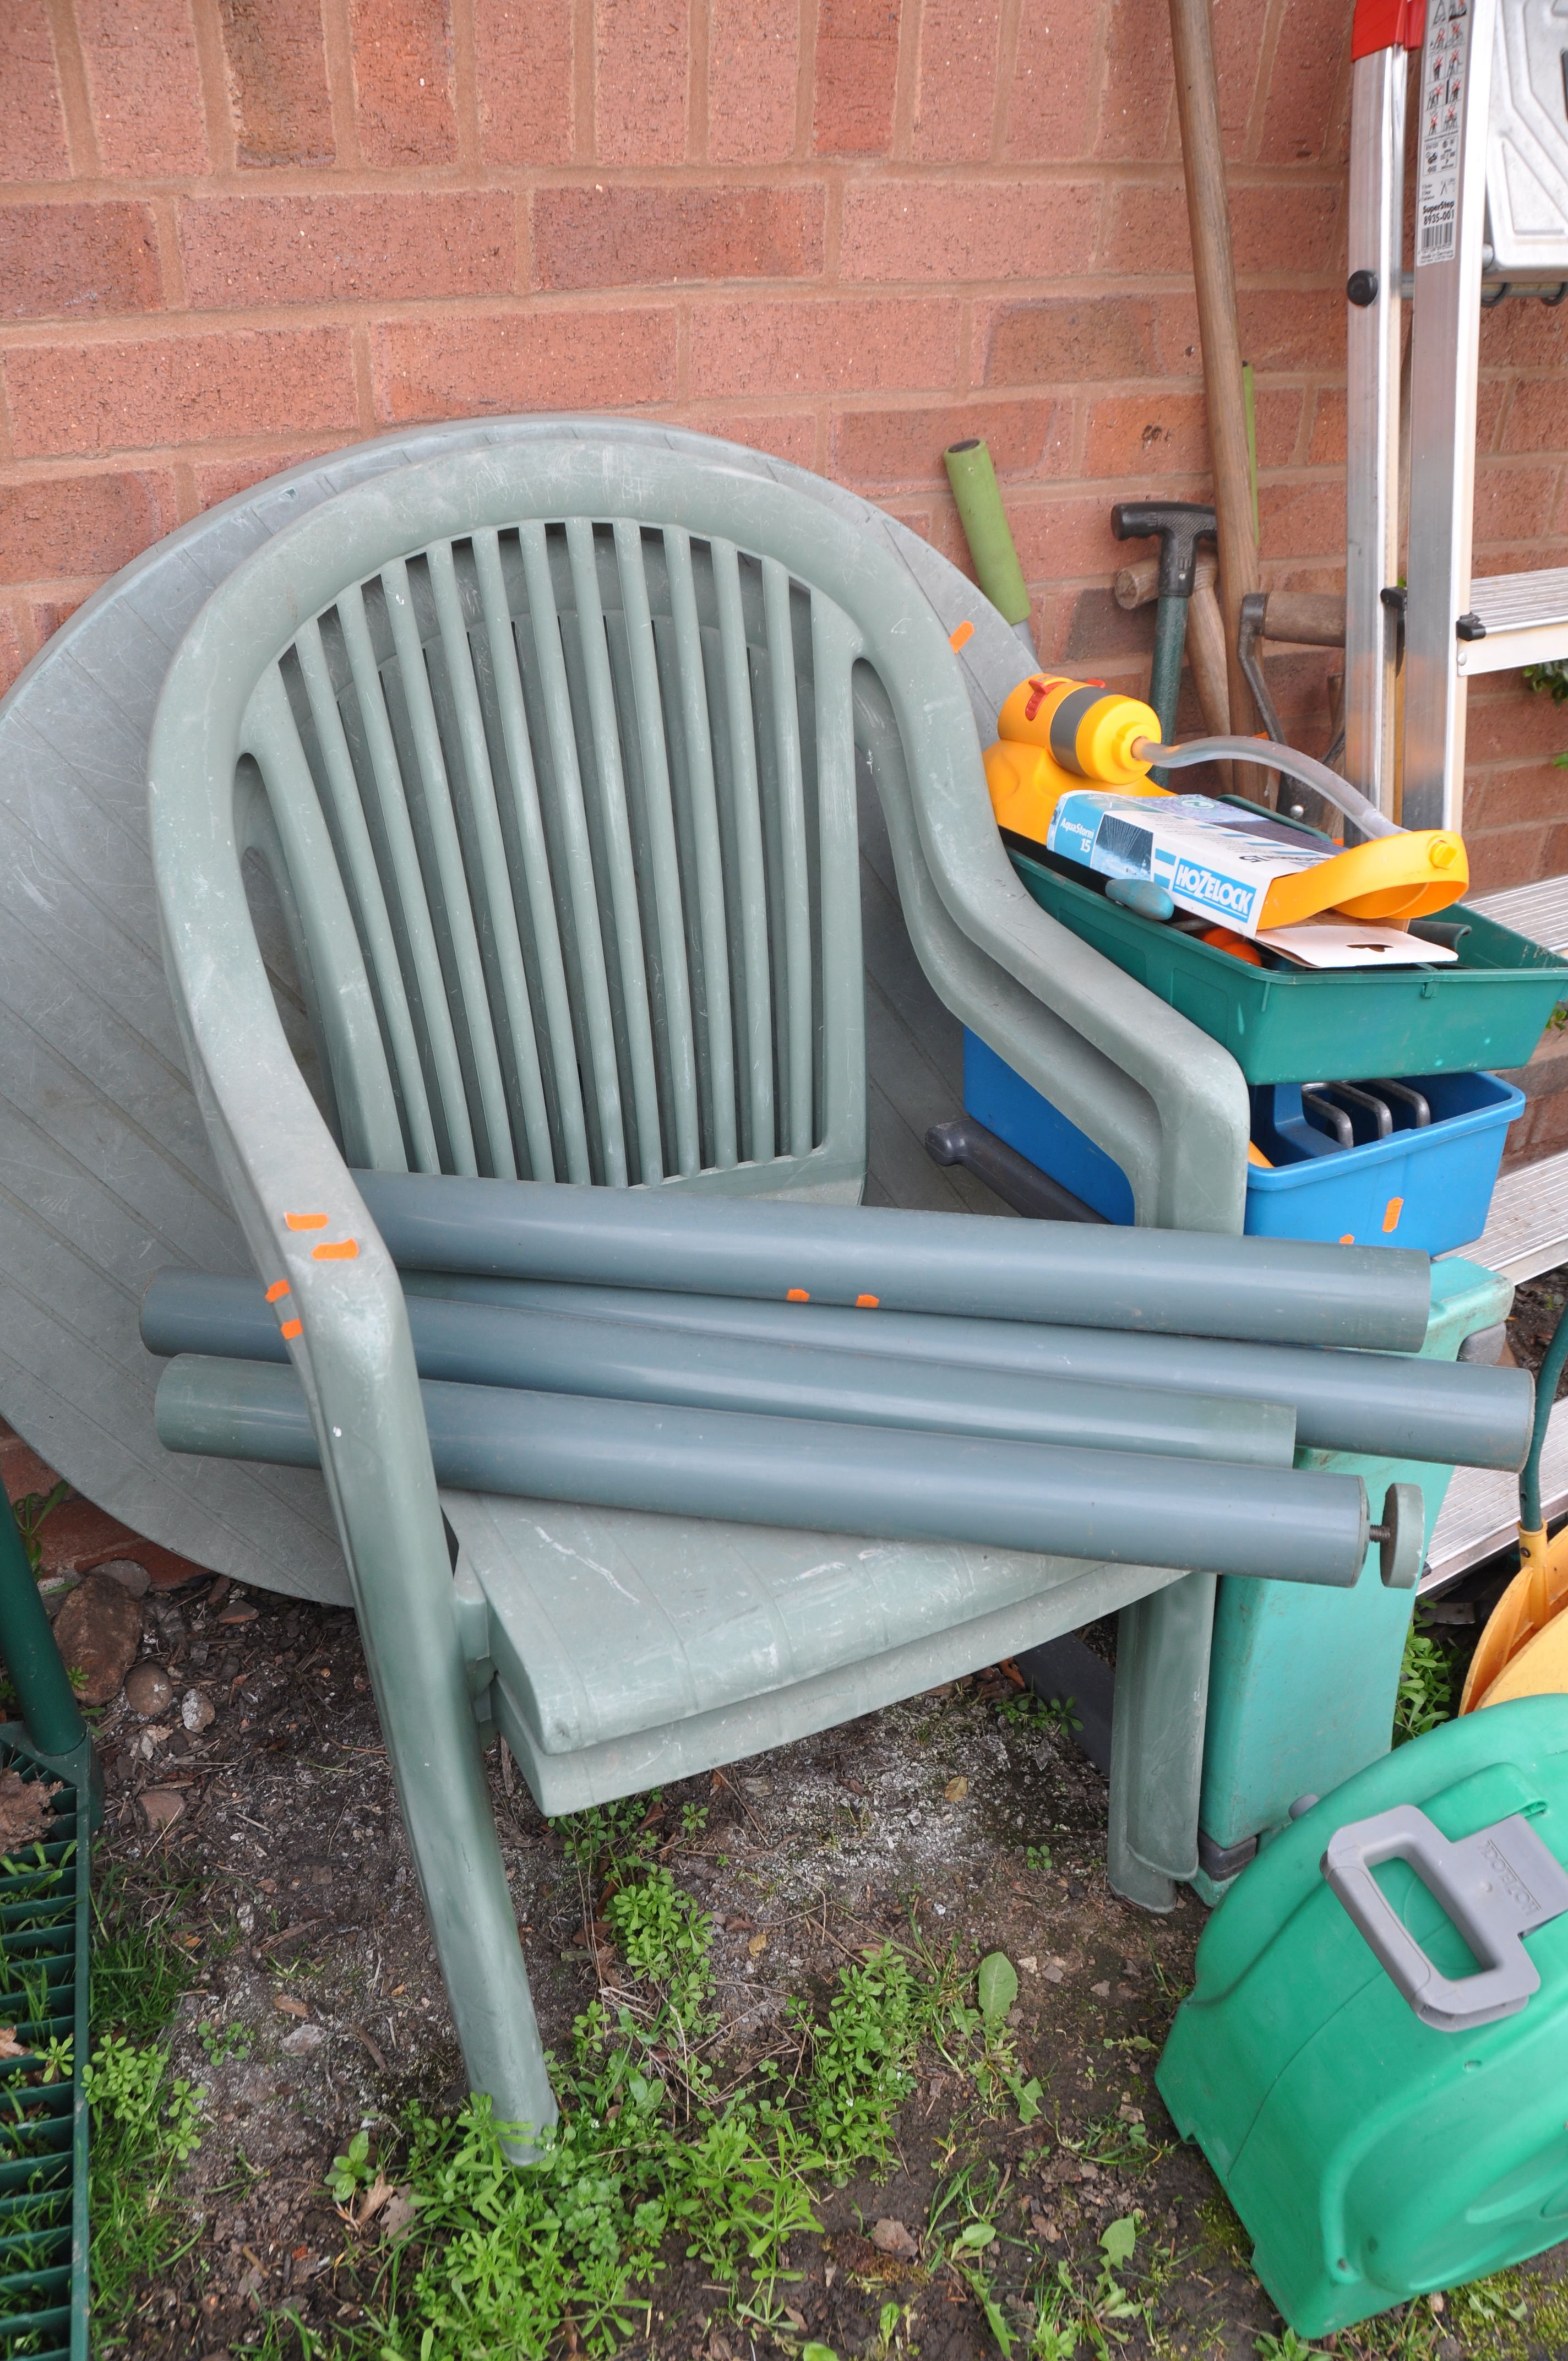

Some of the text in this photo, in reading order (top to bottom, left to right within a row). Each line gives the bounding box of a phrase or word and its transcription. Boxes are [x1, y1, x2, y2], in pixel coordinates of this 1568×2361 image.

[1423, 200, 1455, 214] SuperStep
[1423, 209, 1454, 225] 8935-001
[1060, 818, 1095, 839] AquaStorm
[1080, 837, 1092, 853] 15
[1175, 864, 1254, 915] HOZELOCK
[1477, 1840, 1540, 1916] HOZELOCK
